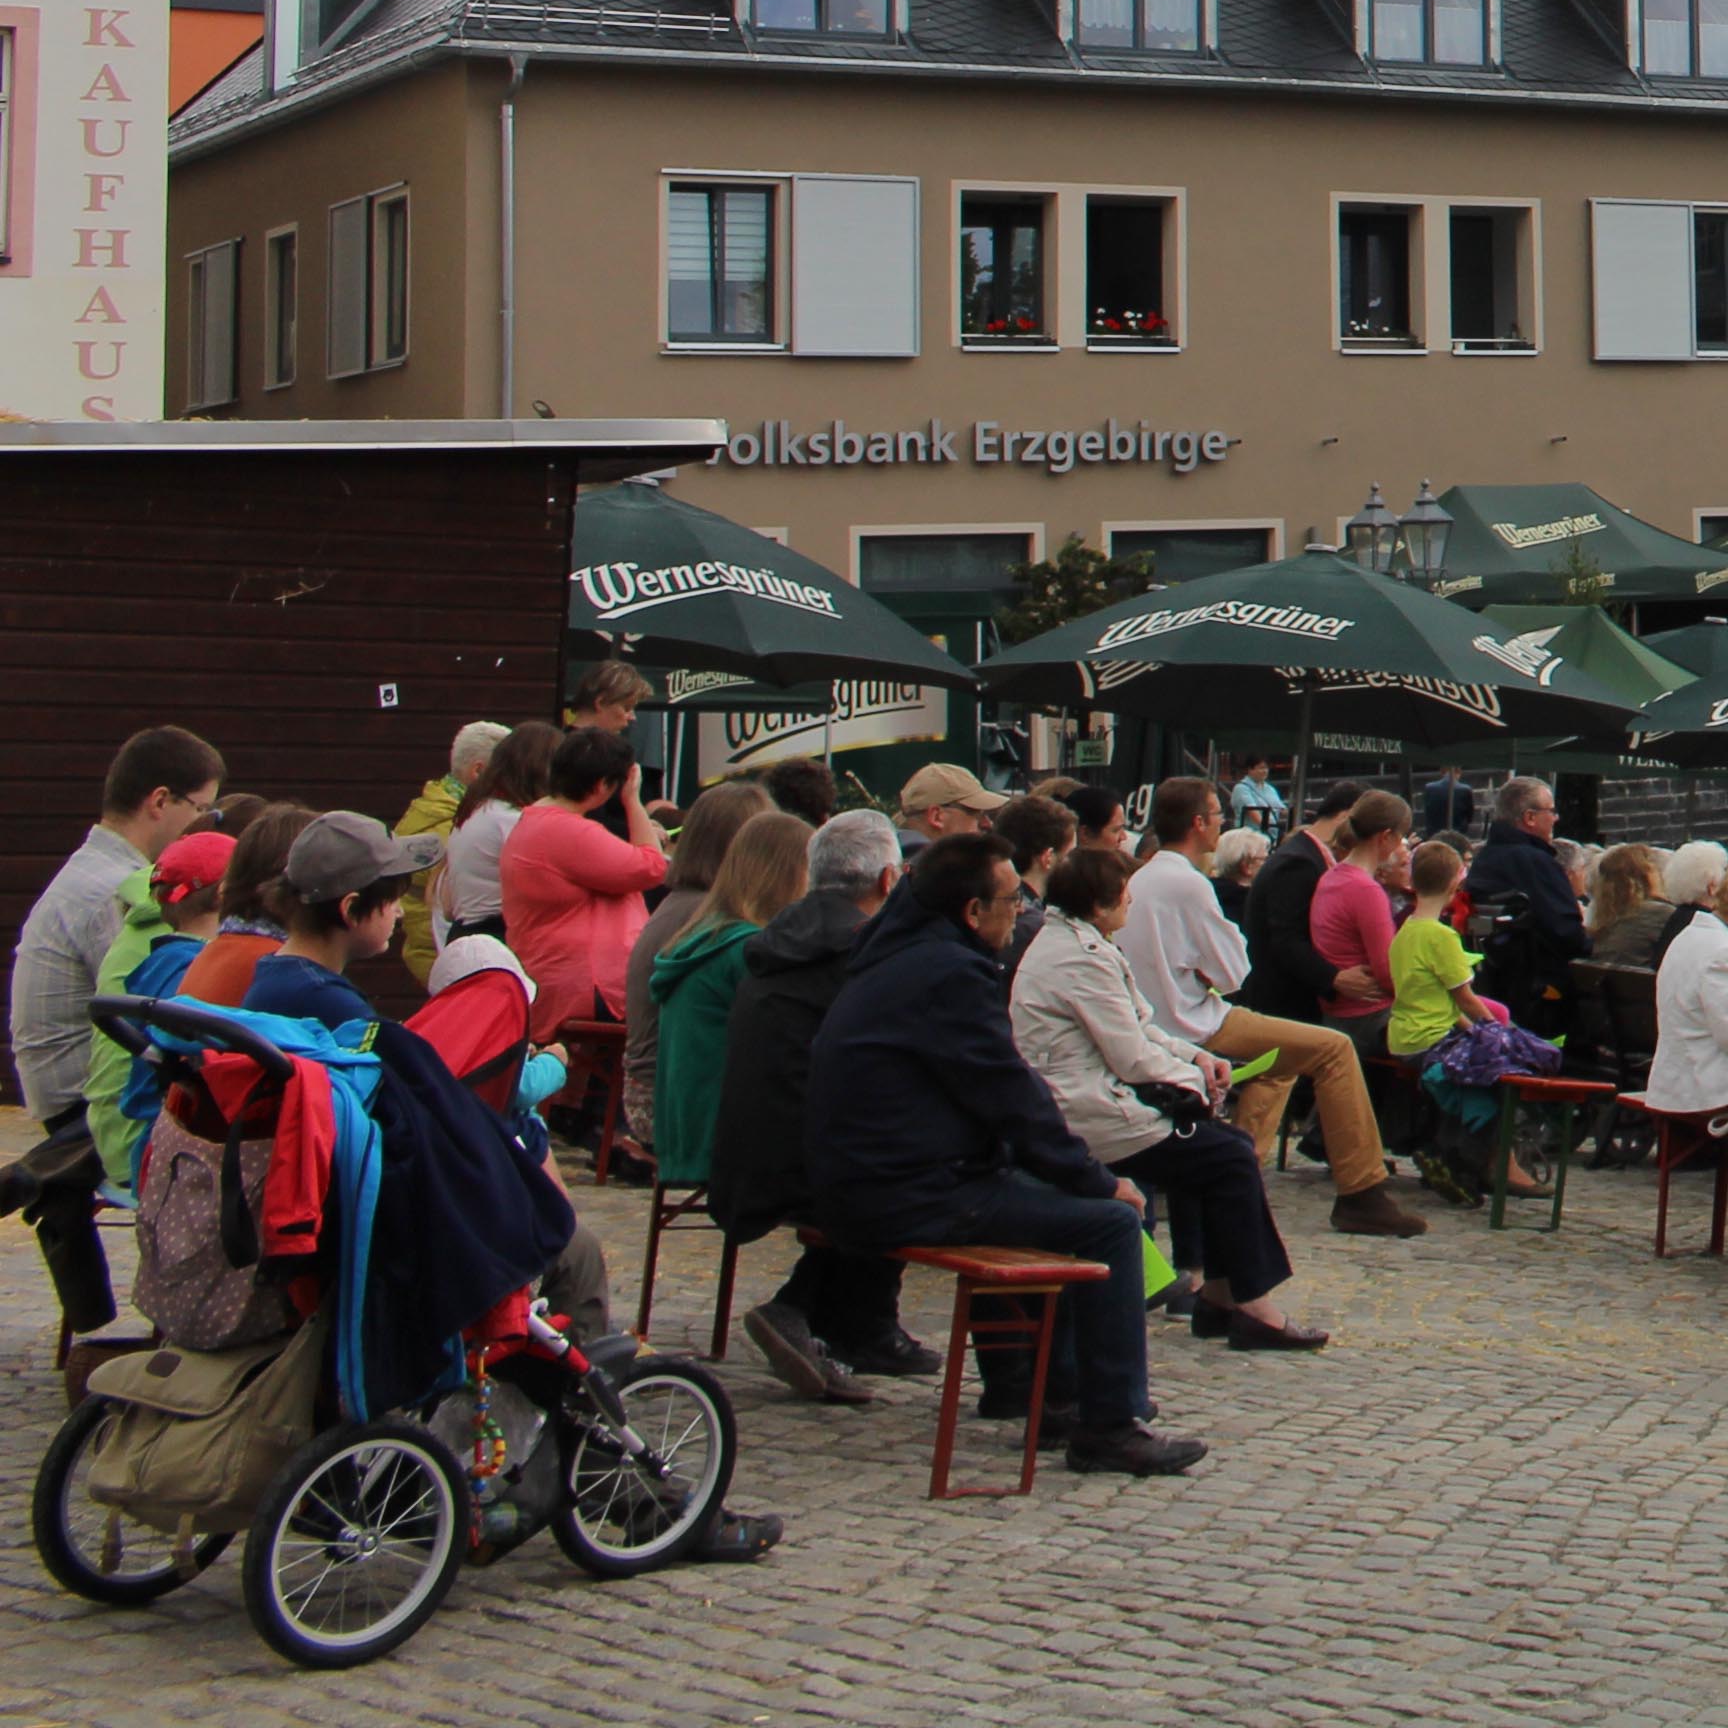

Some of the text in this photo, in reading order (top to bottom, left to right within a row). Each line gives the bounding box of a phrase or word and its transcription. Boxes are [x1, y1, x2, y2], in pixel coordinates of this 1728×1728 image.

[706, 419, 1229, 474] olksbank Erzgebirge
[569, 560, 839, 613] Wernesgrüner
[1094, 599, 1356, 648] Wernesgrüner
